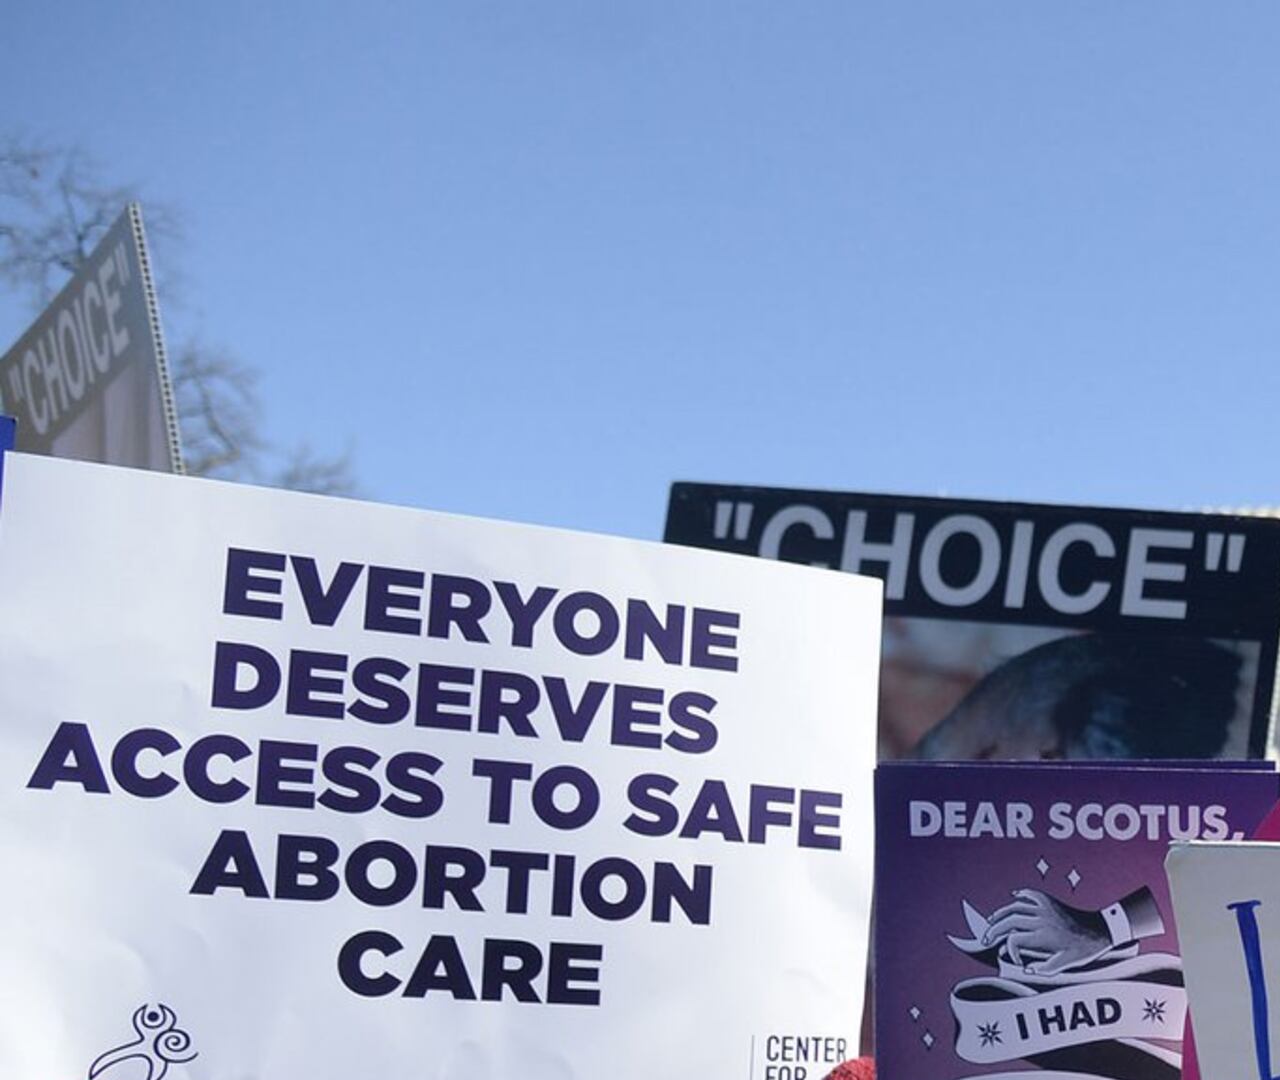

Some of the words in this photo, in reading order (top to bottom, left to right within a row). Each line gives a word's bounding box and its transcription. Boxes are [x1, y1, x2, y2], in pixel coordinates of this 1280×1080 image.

[8, 241, 131, 436] "CHOICE"
[222, 546, 742, 673] EVERYONE
[713, 500, 1247, 621] "CHOICE"
[211, 640, 718, 755] DESERVES
[26, 721, 446, 818] ACCESS
[472, 758, 600, 831] TO
[622, 773, 844, 852] SAFE
[909, 800, 1034, 839] DEAR
[1049, 802, 1246, 842] SCOTUS,
[190, 828, 714, 926] ABORTION
[337, 929, 604, 1007] CARE
[1015, 1013, 1030, 1041] I
[1038, 998, 1122, 1034] HAD
[766, 1035, 847, 1062] CENTER
